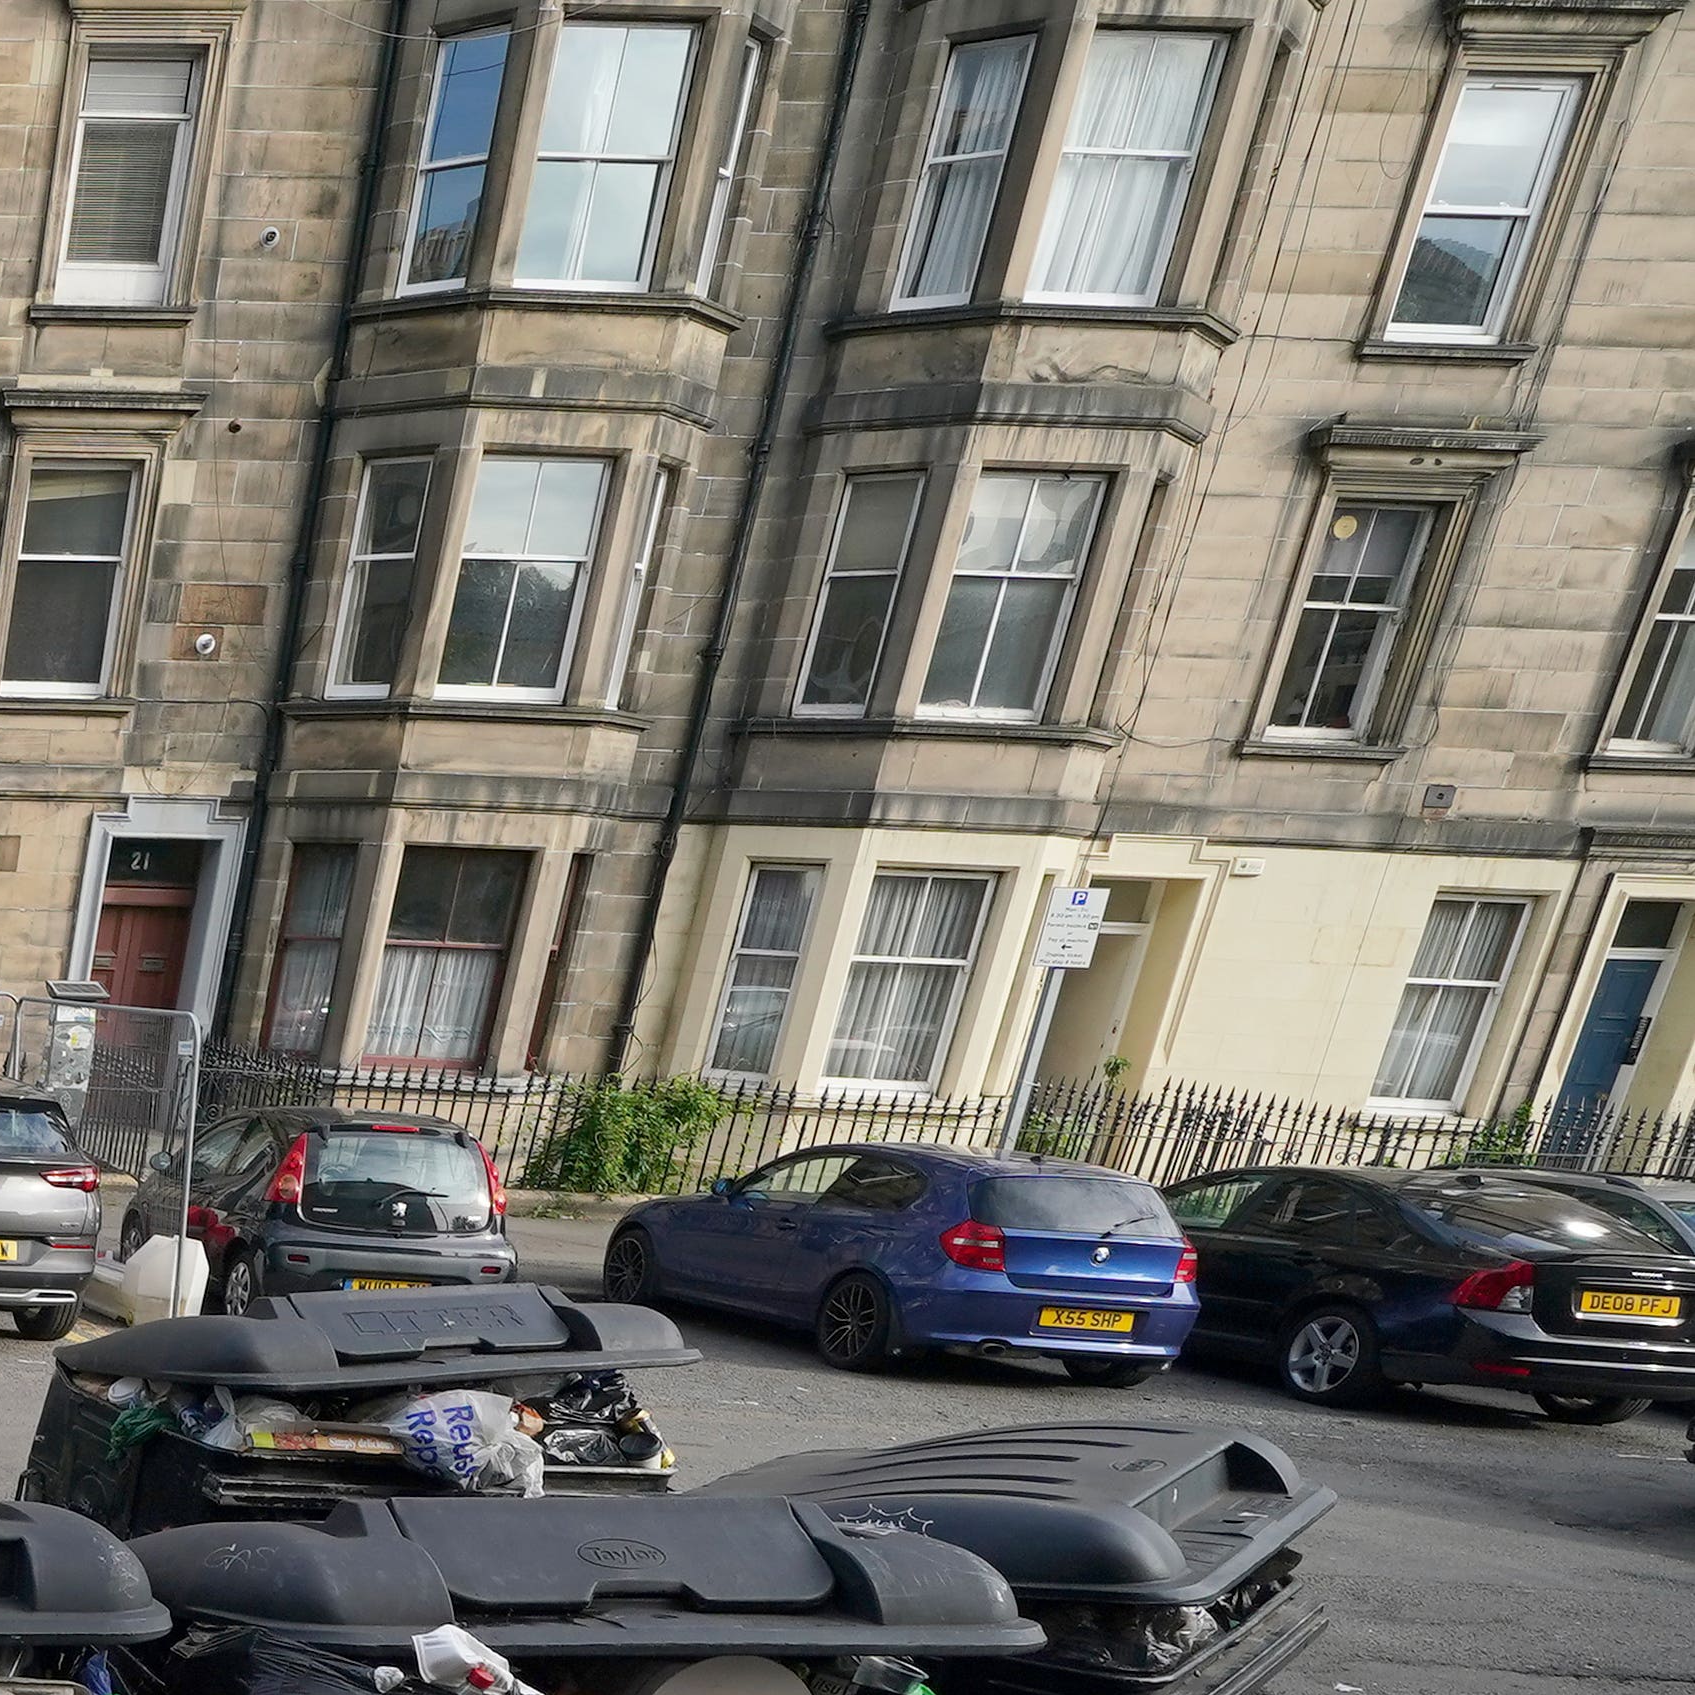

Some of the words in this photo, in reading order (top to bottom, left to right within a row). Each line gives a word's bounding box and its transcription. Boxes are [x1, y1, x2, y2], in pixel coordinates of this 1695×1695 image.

[130, 851, 151, 872] 21
[1589, 1294, 1635, 1312] DE08
[1639, 1297, 1673, 1314] PFJ
[1052, 1310, 1087, 1326] X55
[1090, 1312, 1122, 1328] SHP
[327, 1434, 358, 1450] Simply
